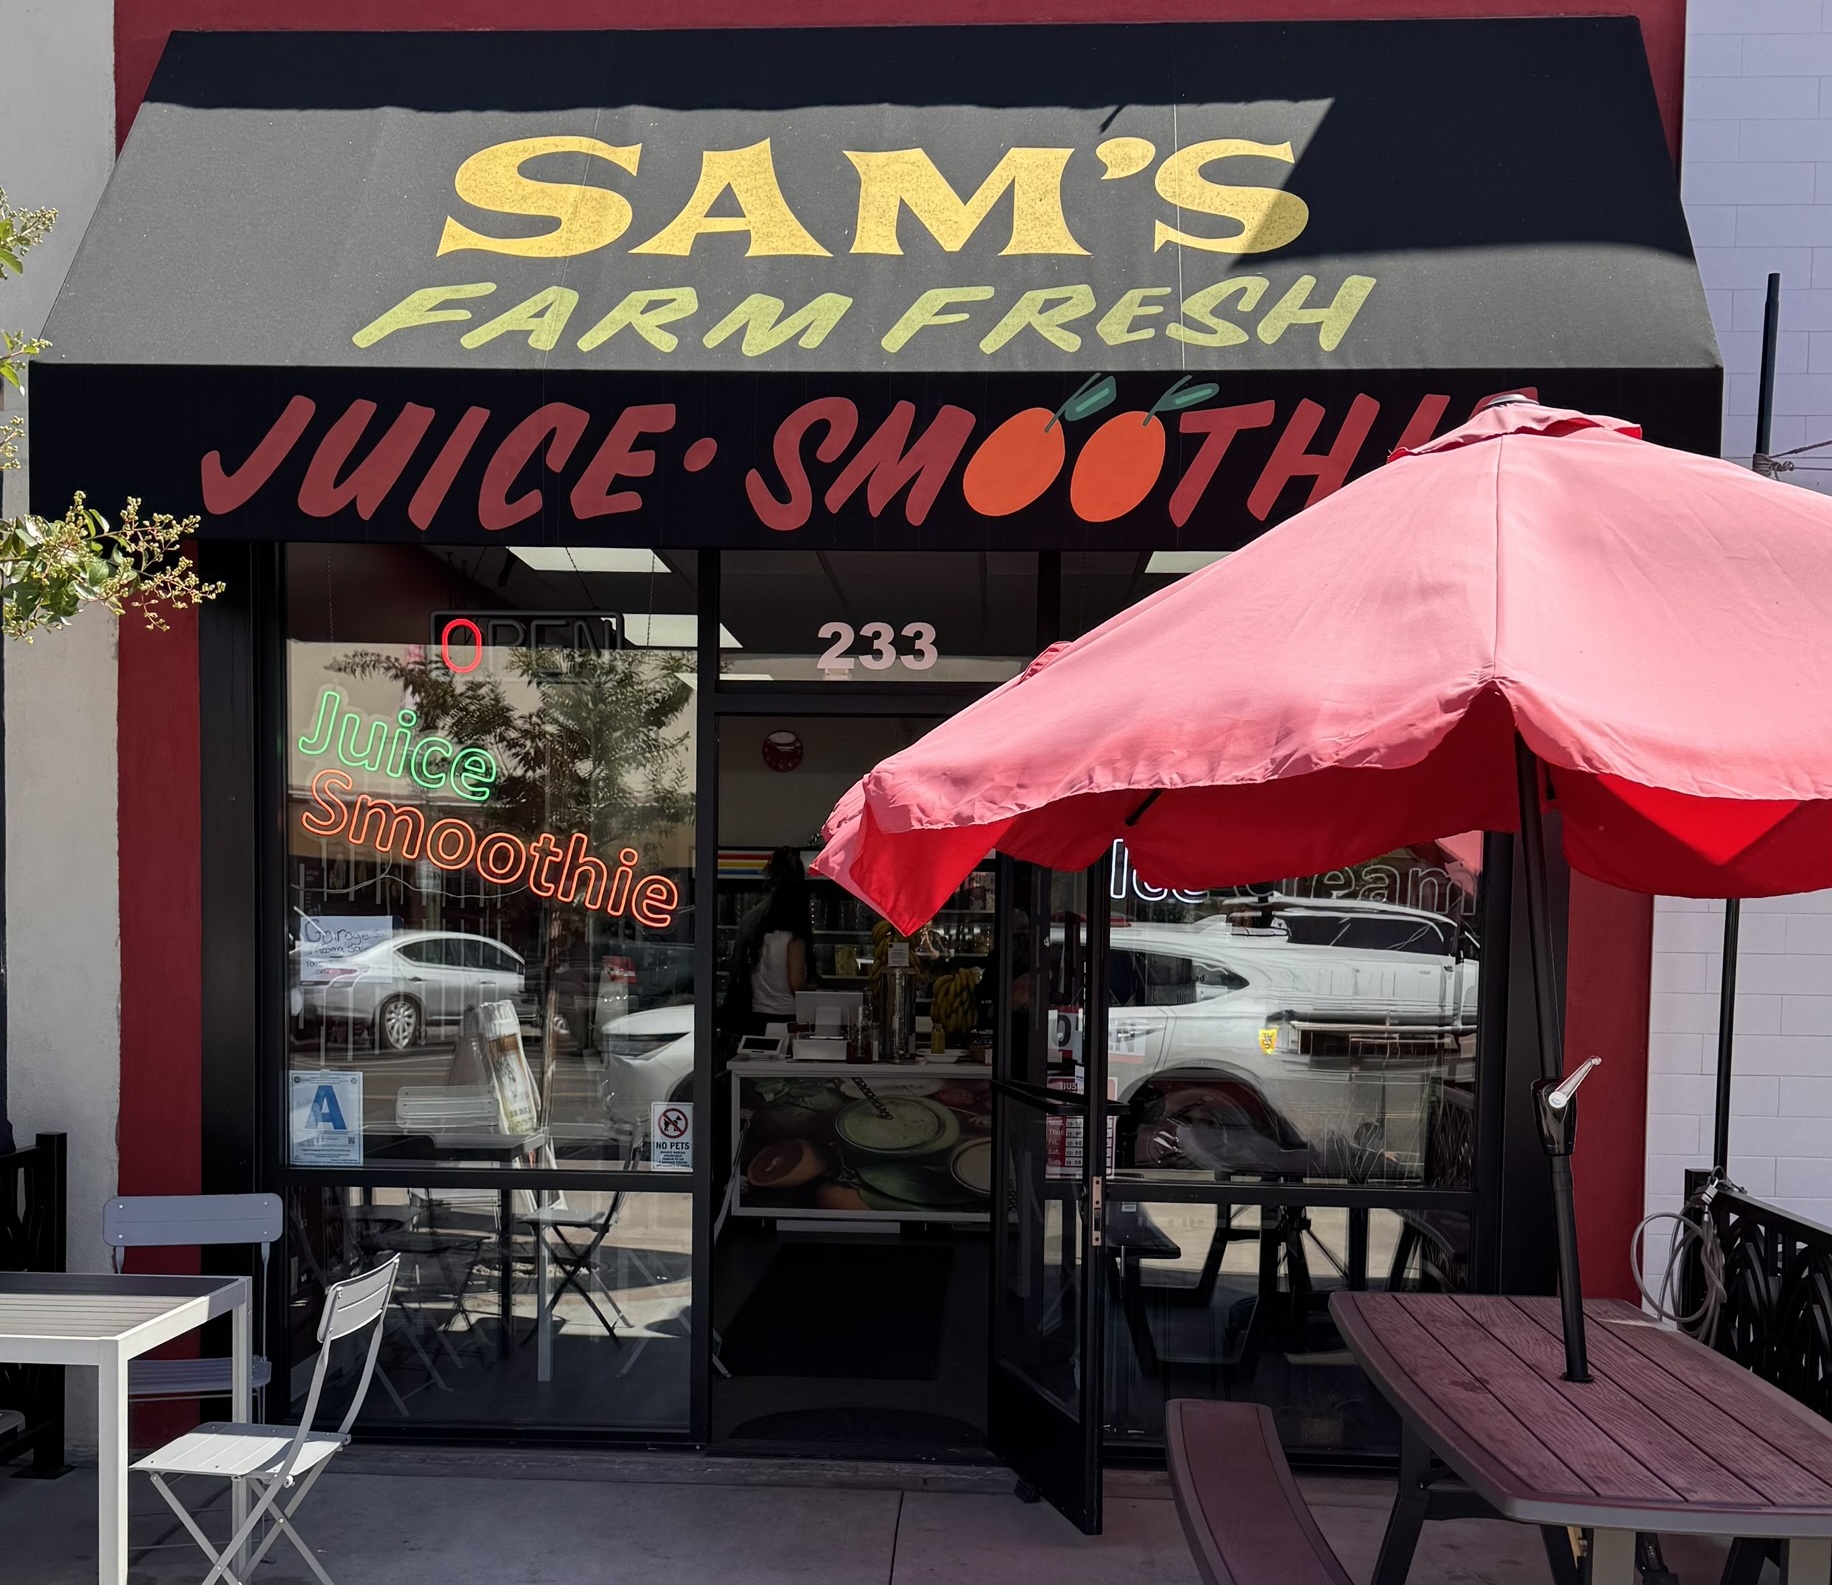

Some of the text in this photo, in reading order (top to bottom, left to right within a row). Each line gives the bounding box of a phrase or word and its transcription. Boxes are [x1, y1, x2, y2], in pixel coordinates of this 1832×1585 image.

[436, 135, 1310, 258] SAM'S
[352, 275, 1377, 356] FARM FRESH
[745, 387, 1538, 530] SMOOTH
[816, 621, 939, 671] 233
[298, 690, 497, 801] Juice
[301, 768, 678, 928] Smoothie
[305, 1085, 347, 1129] A
[656, 1141, 690, 1150] NO PETS
